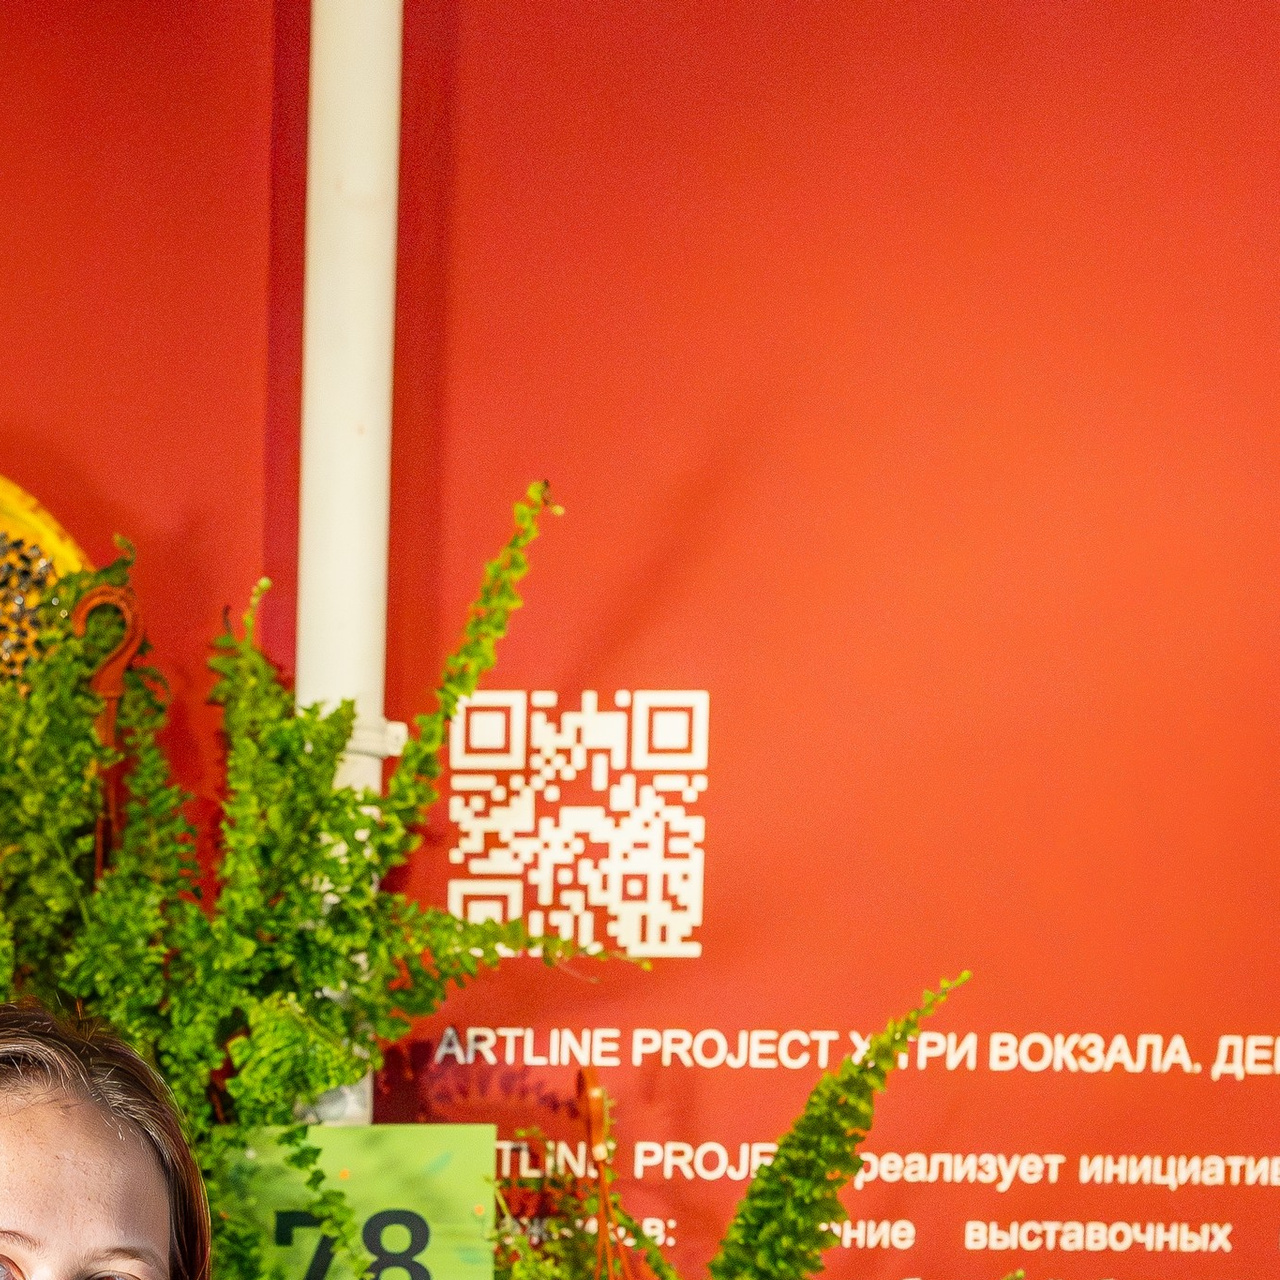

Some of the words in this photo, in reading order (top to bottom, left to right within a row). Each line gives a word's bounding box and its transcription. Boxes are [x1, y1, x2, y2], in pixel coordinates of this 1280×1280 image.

[434, 1026, 621, 1067] ARTLINE
[631, 1028, 840, 1069] PROJECT
[988, 1032, 1203, 1074] ВОКЗАЛА.
[1210, 1034, 1280, 1082] ДЕ
[633, 1140, 779, 1181] PROJE
[853, 1151, 1067, 1193] реализует
[964, 1219, 1233, 1253] выставочных
